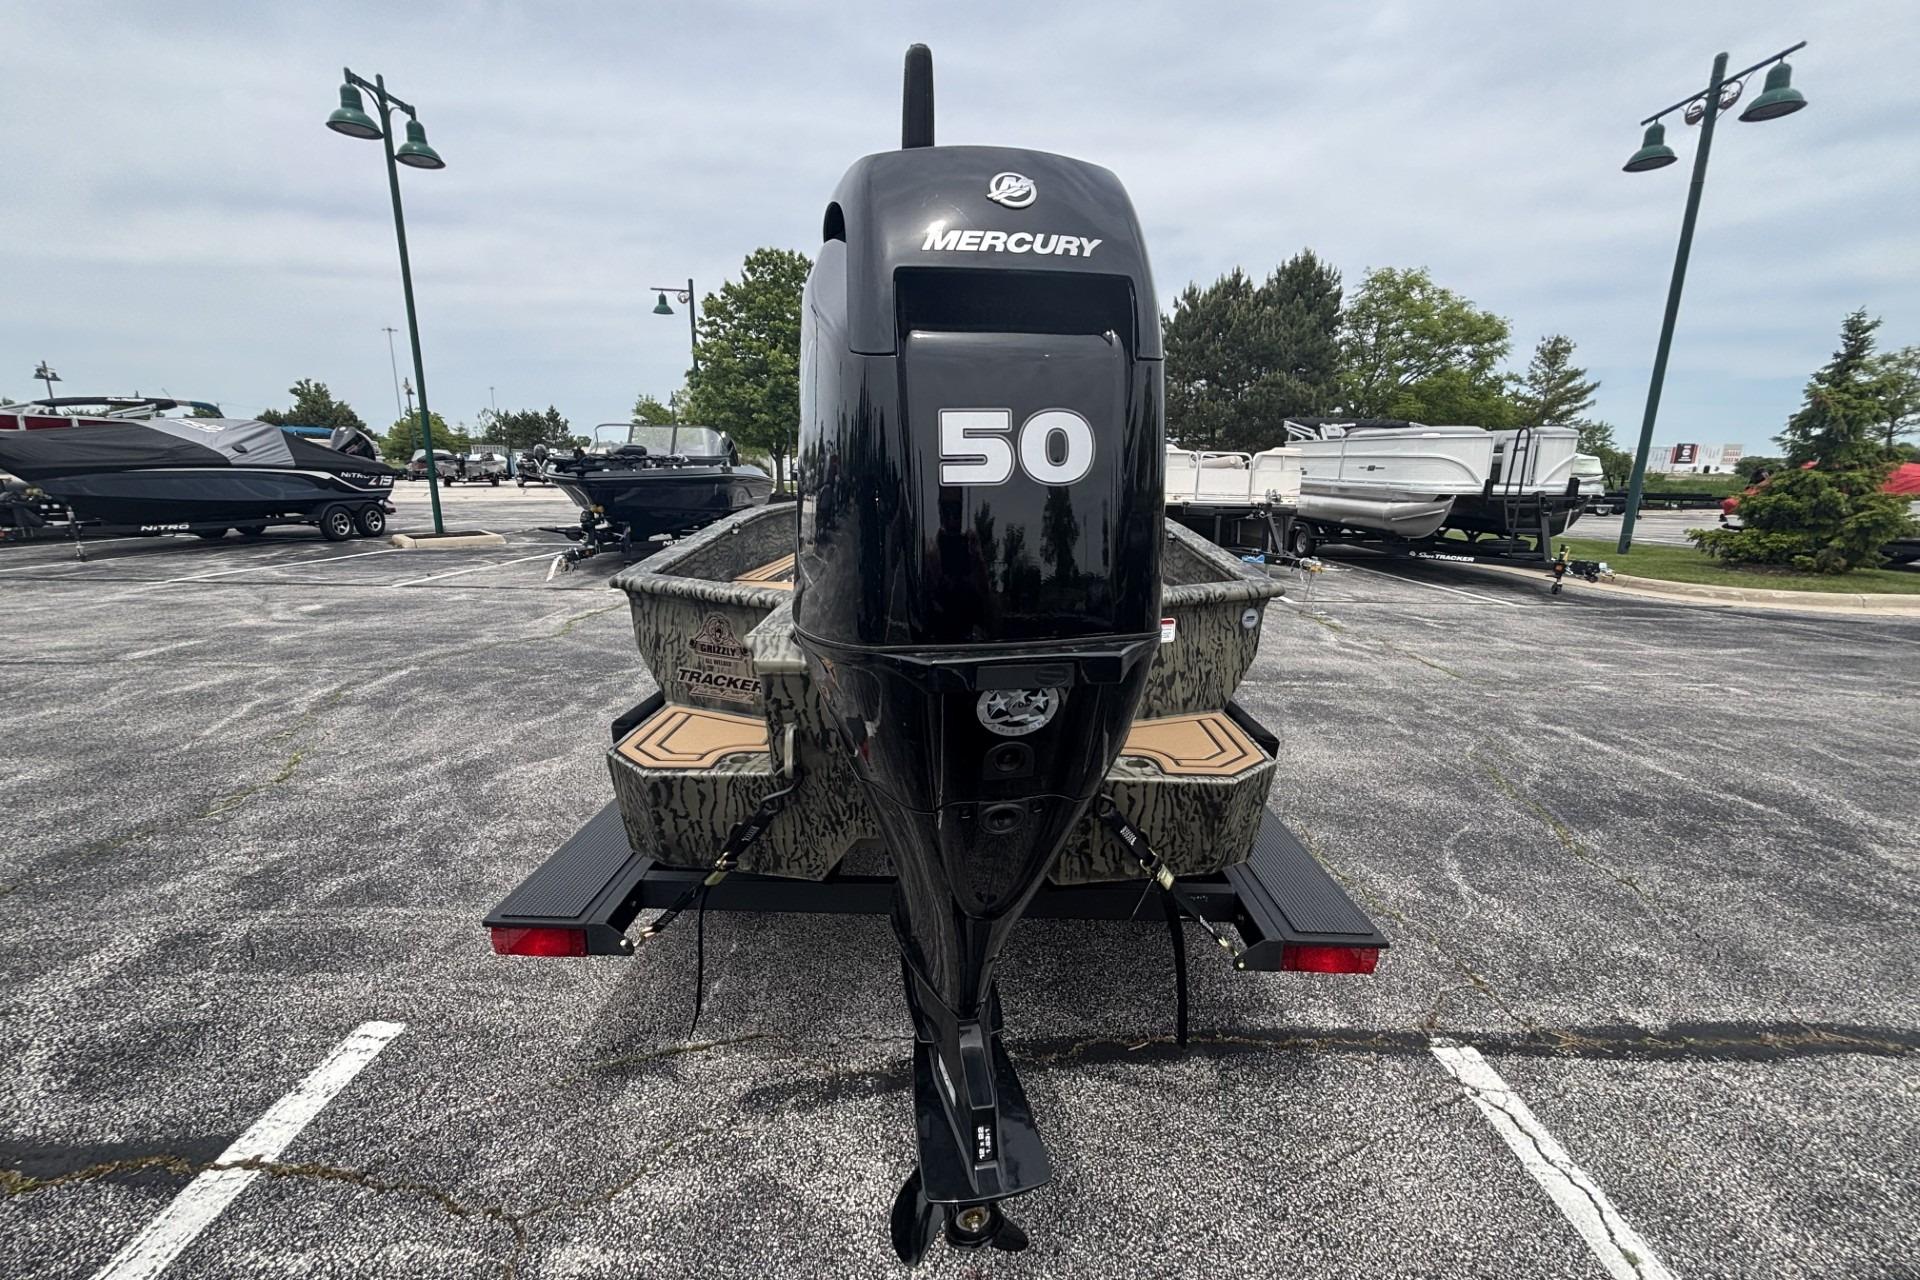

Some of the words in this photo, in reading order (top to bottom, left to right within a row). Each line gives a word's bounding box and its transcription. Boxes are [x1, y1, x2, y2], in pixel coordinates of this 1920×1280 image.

[921, 220, 1102, 257] MERCURY
[938, 408, 1096, 486] 50
[1435, 553, 1475, 562] TRACKER
[700, 643, 736, 657] GRIZZLY
[678, 668, 762, 692] TRACKER
